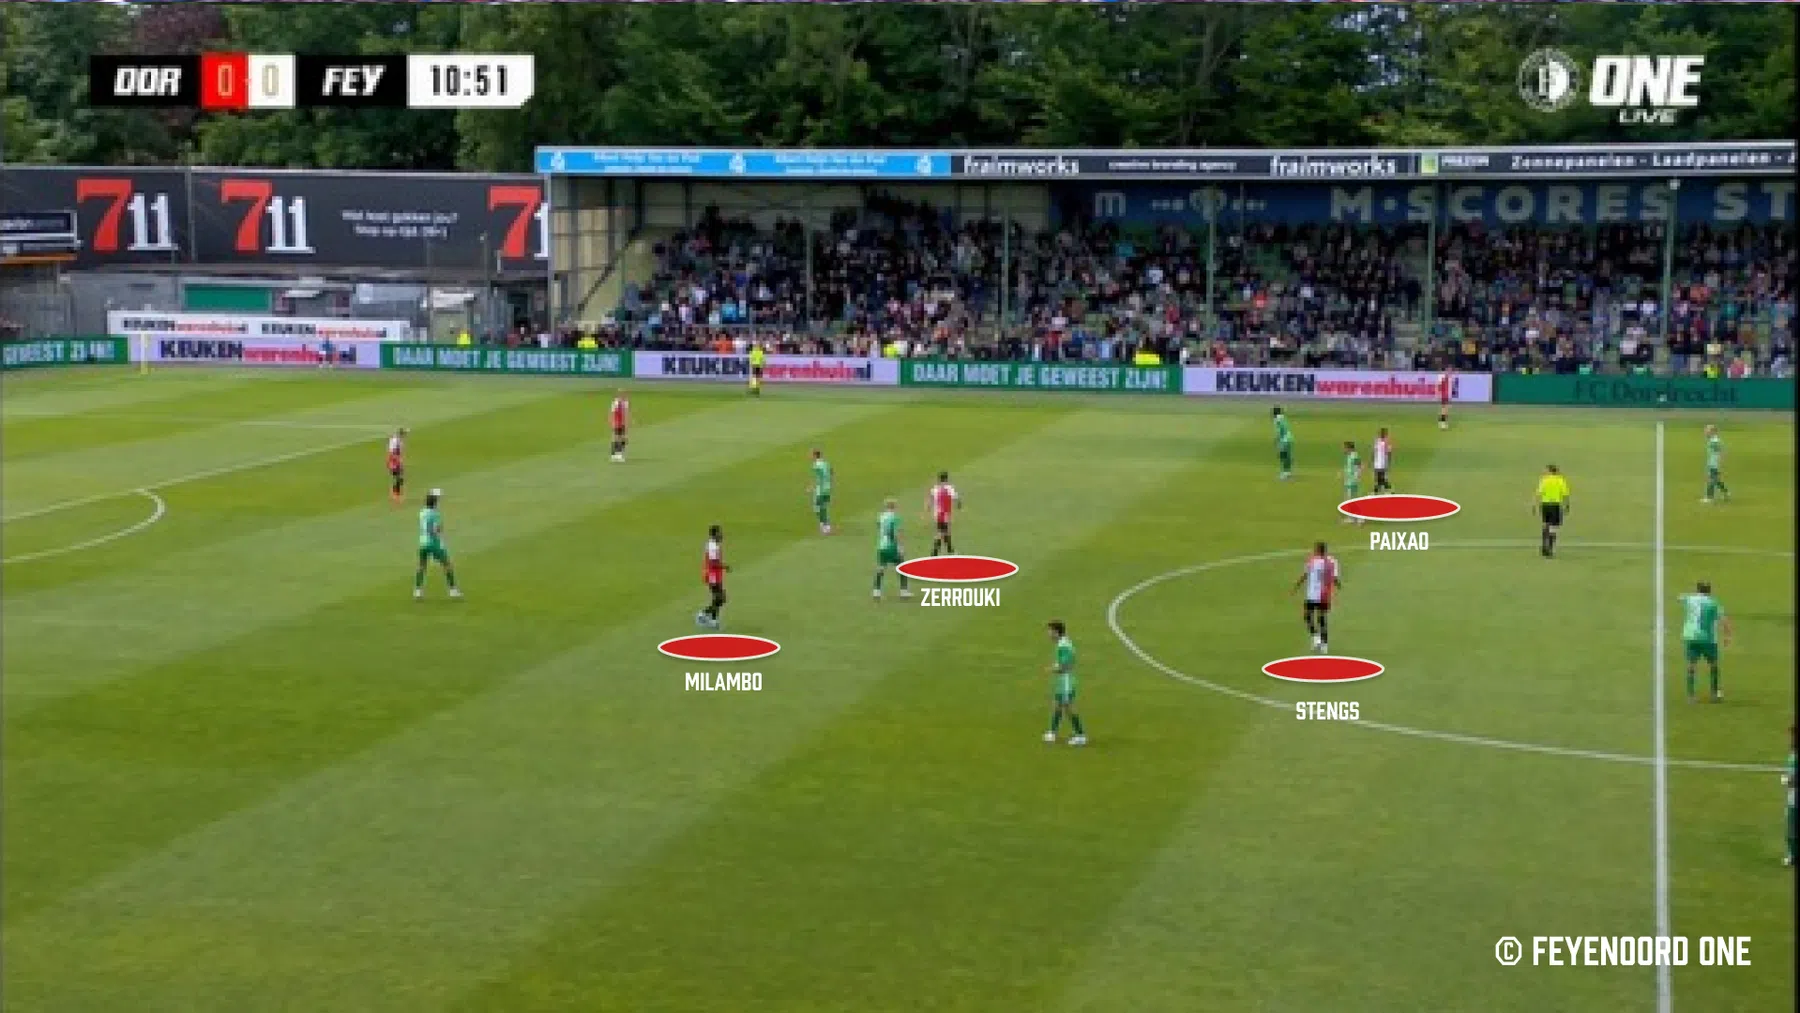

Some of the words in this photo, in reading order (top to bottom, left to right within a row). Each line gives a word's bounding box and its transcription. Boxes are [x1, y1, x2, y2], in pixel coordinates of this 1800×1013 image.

[963, 154, 1080, 177] fraimworks
[1270, 155, 1396, 179] fraimworks
[488, 185, 549, 258] 71
[913, 363, 959, 382] DAAR
[963, 364, 1012, 385] MOET
[1015, 365, 1036, 386] JE
[1038, 366, 1120, 388] GEWEEST
